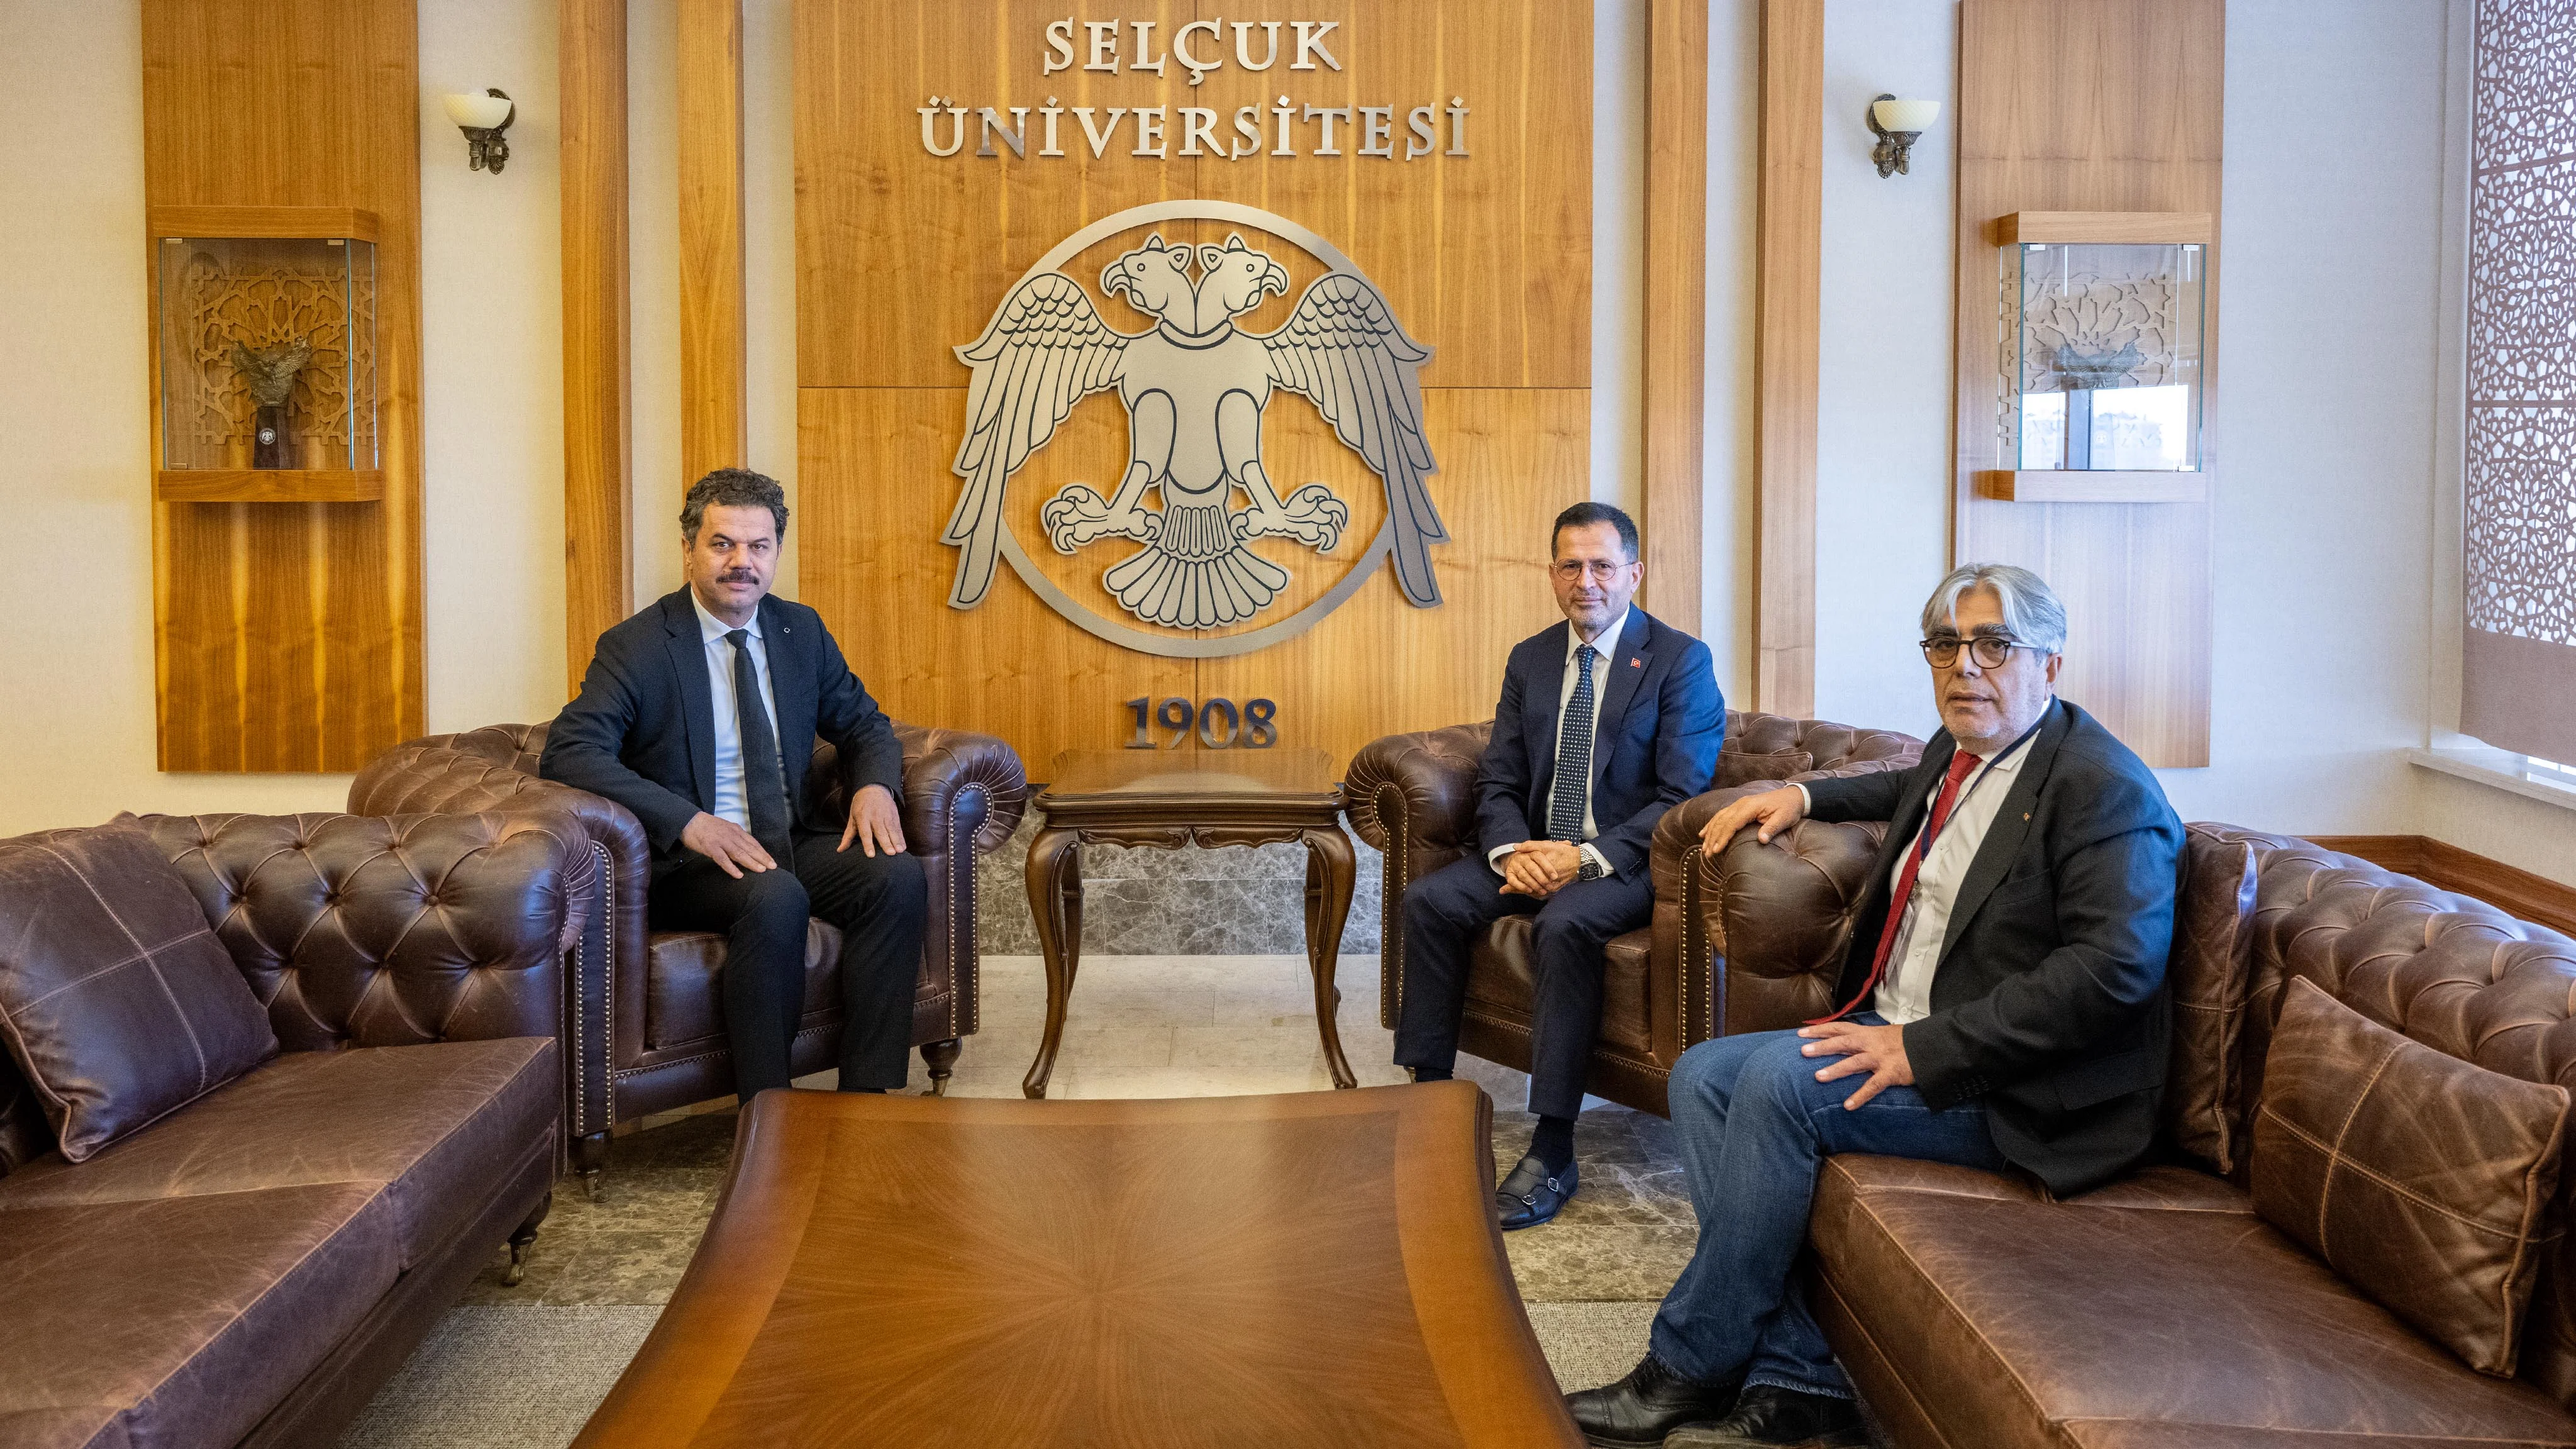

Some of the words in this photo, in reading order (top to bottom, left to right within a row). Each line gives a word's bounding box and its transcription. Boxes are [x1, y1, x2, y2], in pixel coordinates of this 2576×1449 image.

[1044, 17, 1342, 85] SELÇUK
[917, 95, 1470, 161] ÜNİVERSİTESİ
[1124, 696, 1277, 749] 1908
